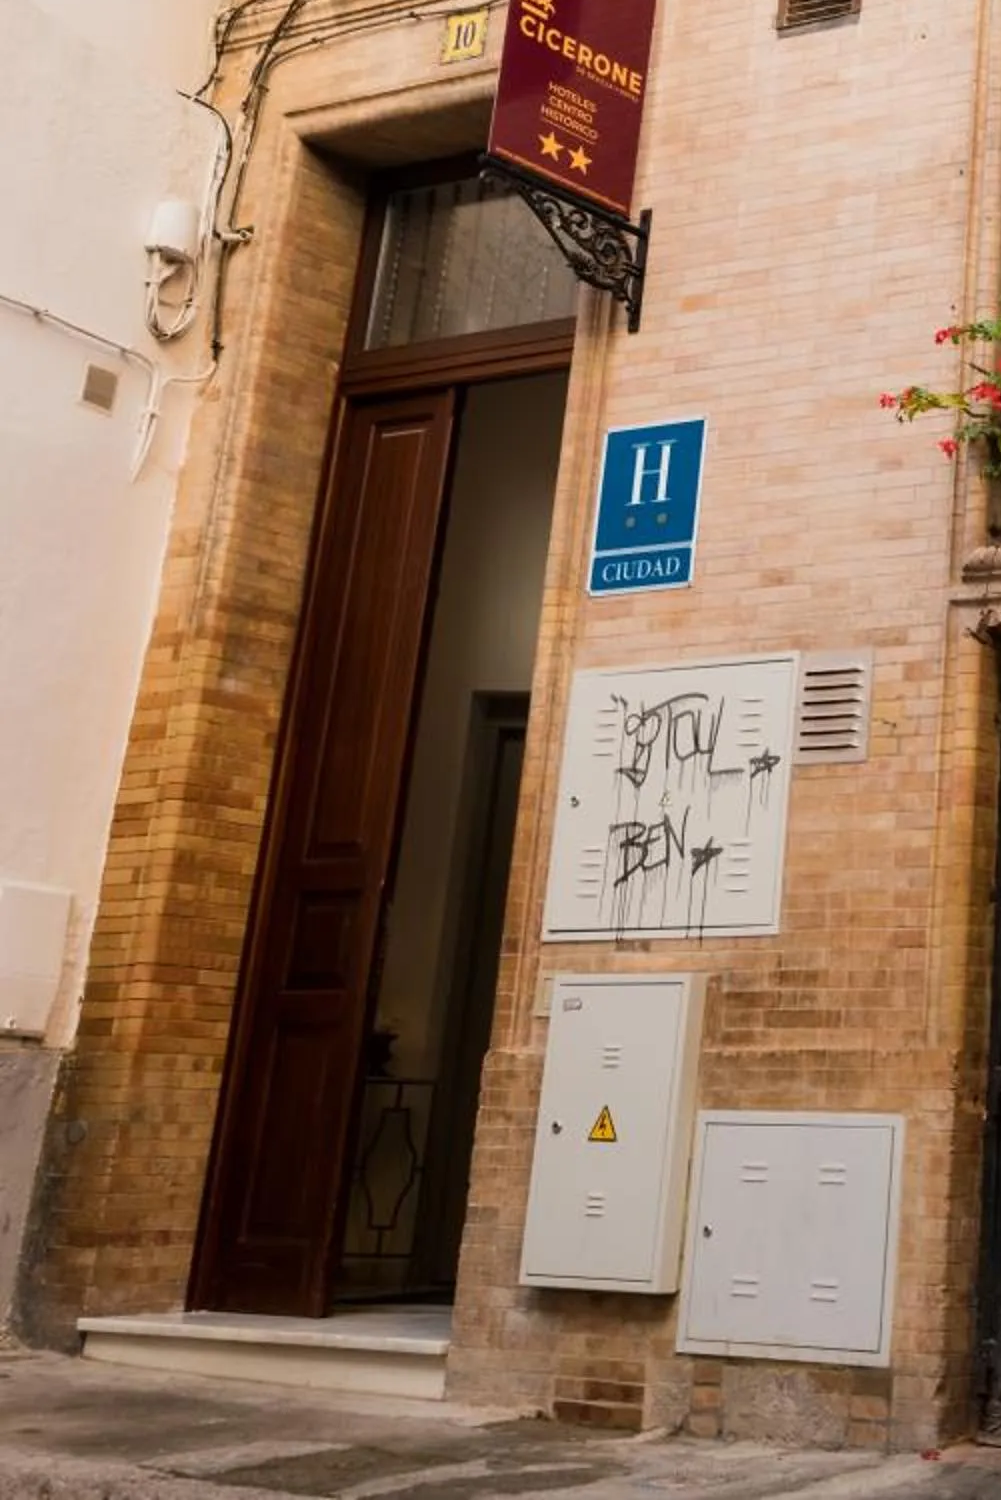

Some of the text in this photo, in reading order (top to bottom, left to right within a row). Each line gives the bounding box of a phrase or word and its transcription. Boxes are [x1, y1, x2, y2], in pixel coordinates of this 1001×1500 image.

[453, 20, 477, 50] 10
[519, 14, 643, 95] CICERONE
[548, 80, 597, 113] HOTELES
[549, 95, 593, 124] CENTRO
[624, 438, 678, 506] H
[601, 556, 681, 583] CIUDAD
